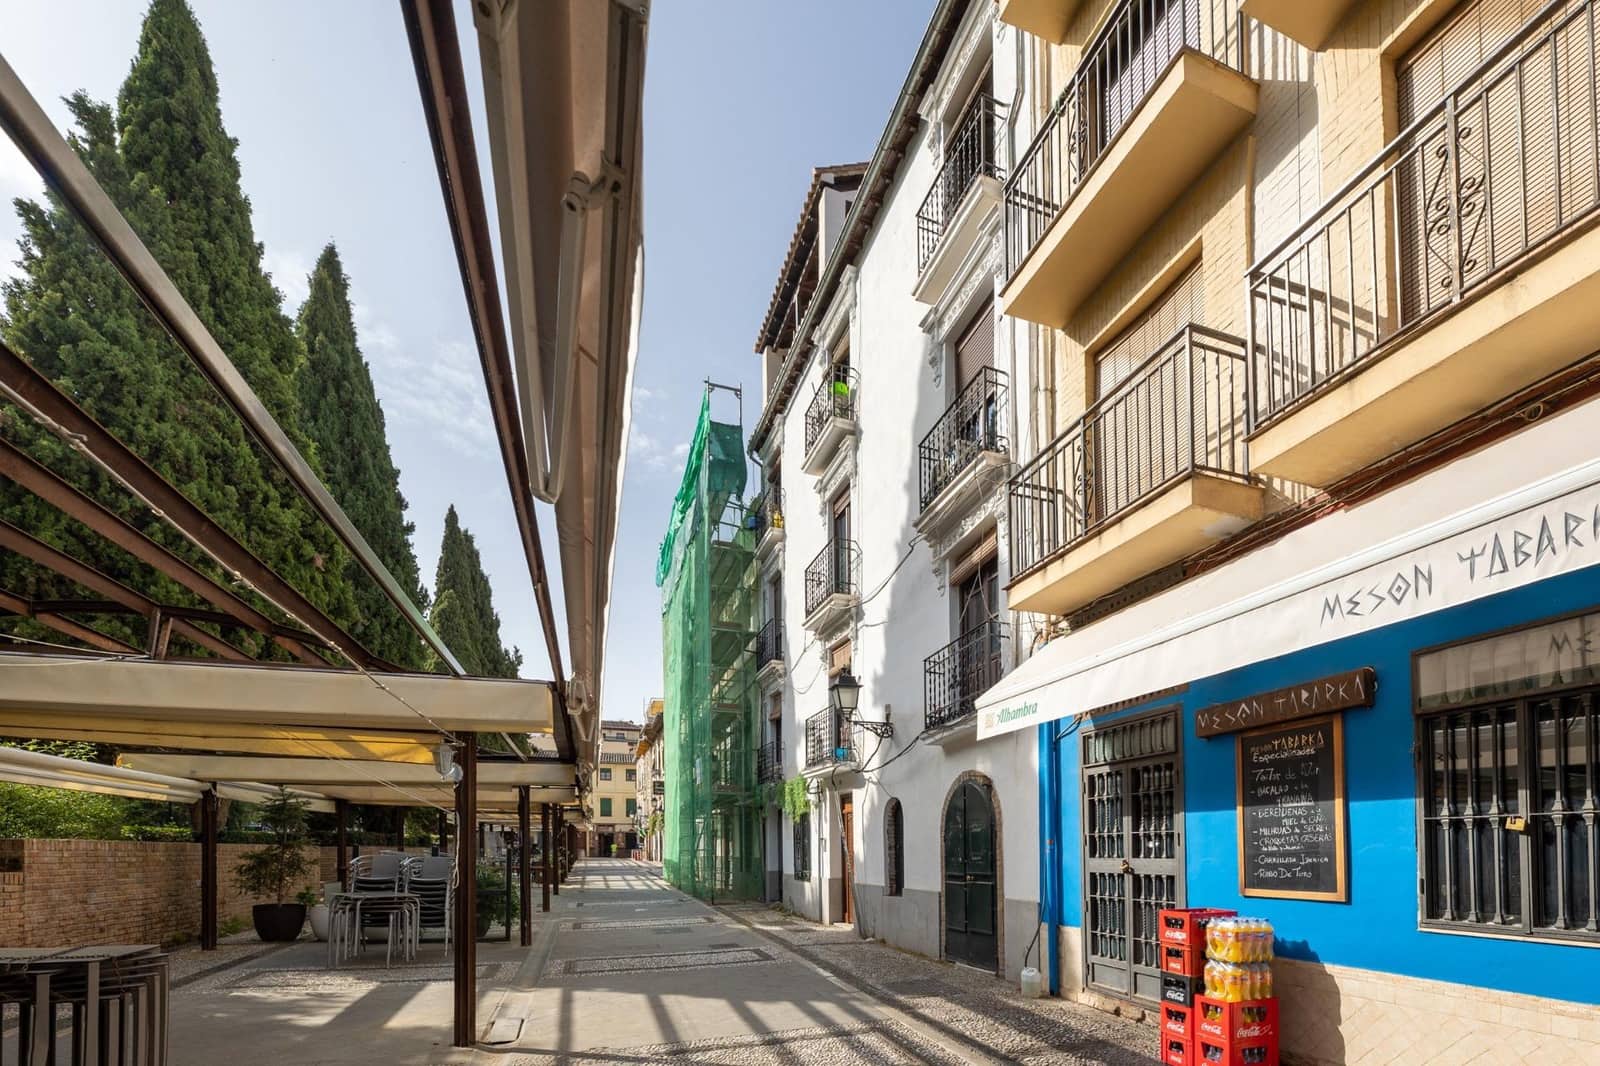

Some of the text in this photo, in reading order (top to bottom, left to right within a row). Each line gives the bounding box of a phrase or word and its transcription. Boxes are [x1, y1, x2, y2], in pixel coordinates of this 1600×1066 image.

[1320, 563, 1433, 628] MESON
[997, 702, 1038, 724] Alhambra
[1198, 674, 1365, 729] MESON TABARKA
[1272, 730, 1325, 750] TABARKA
